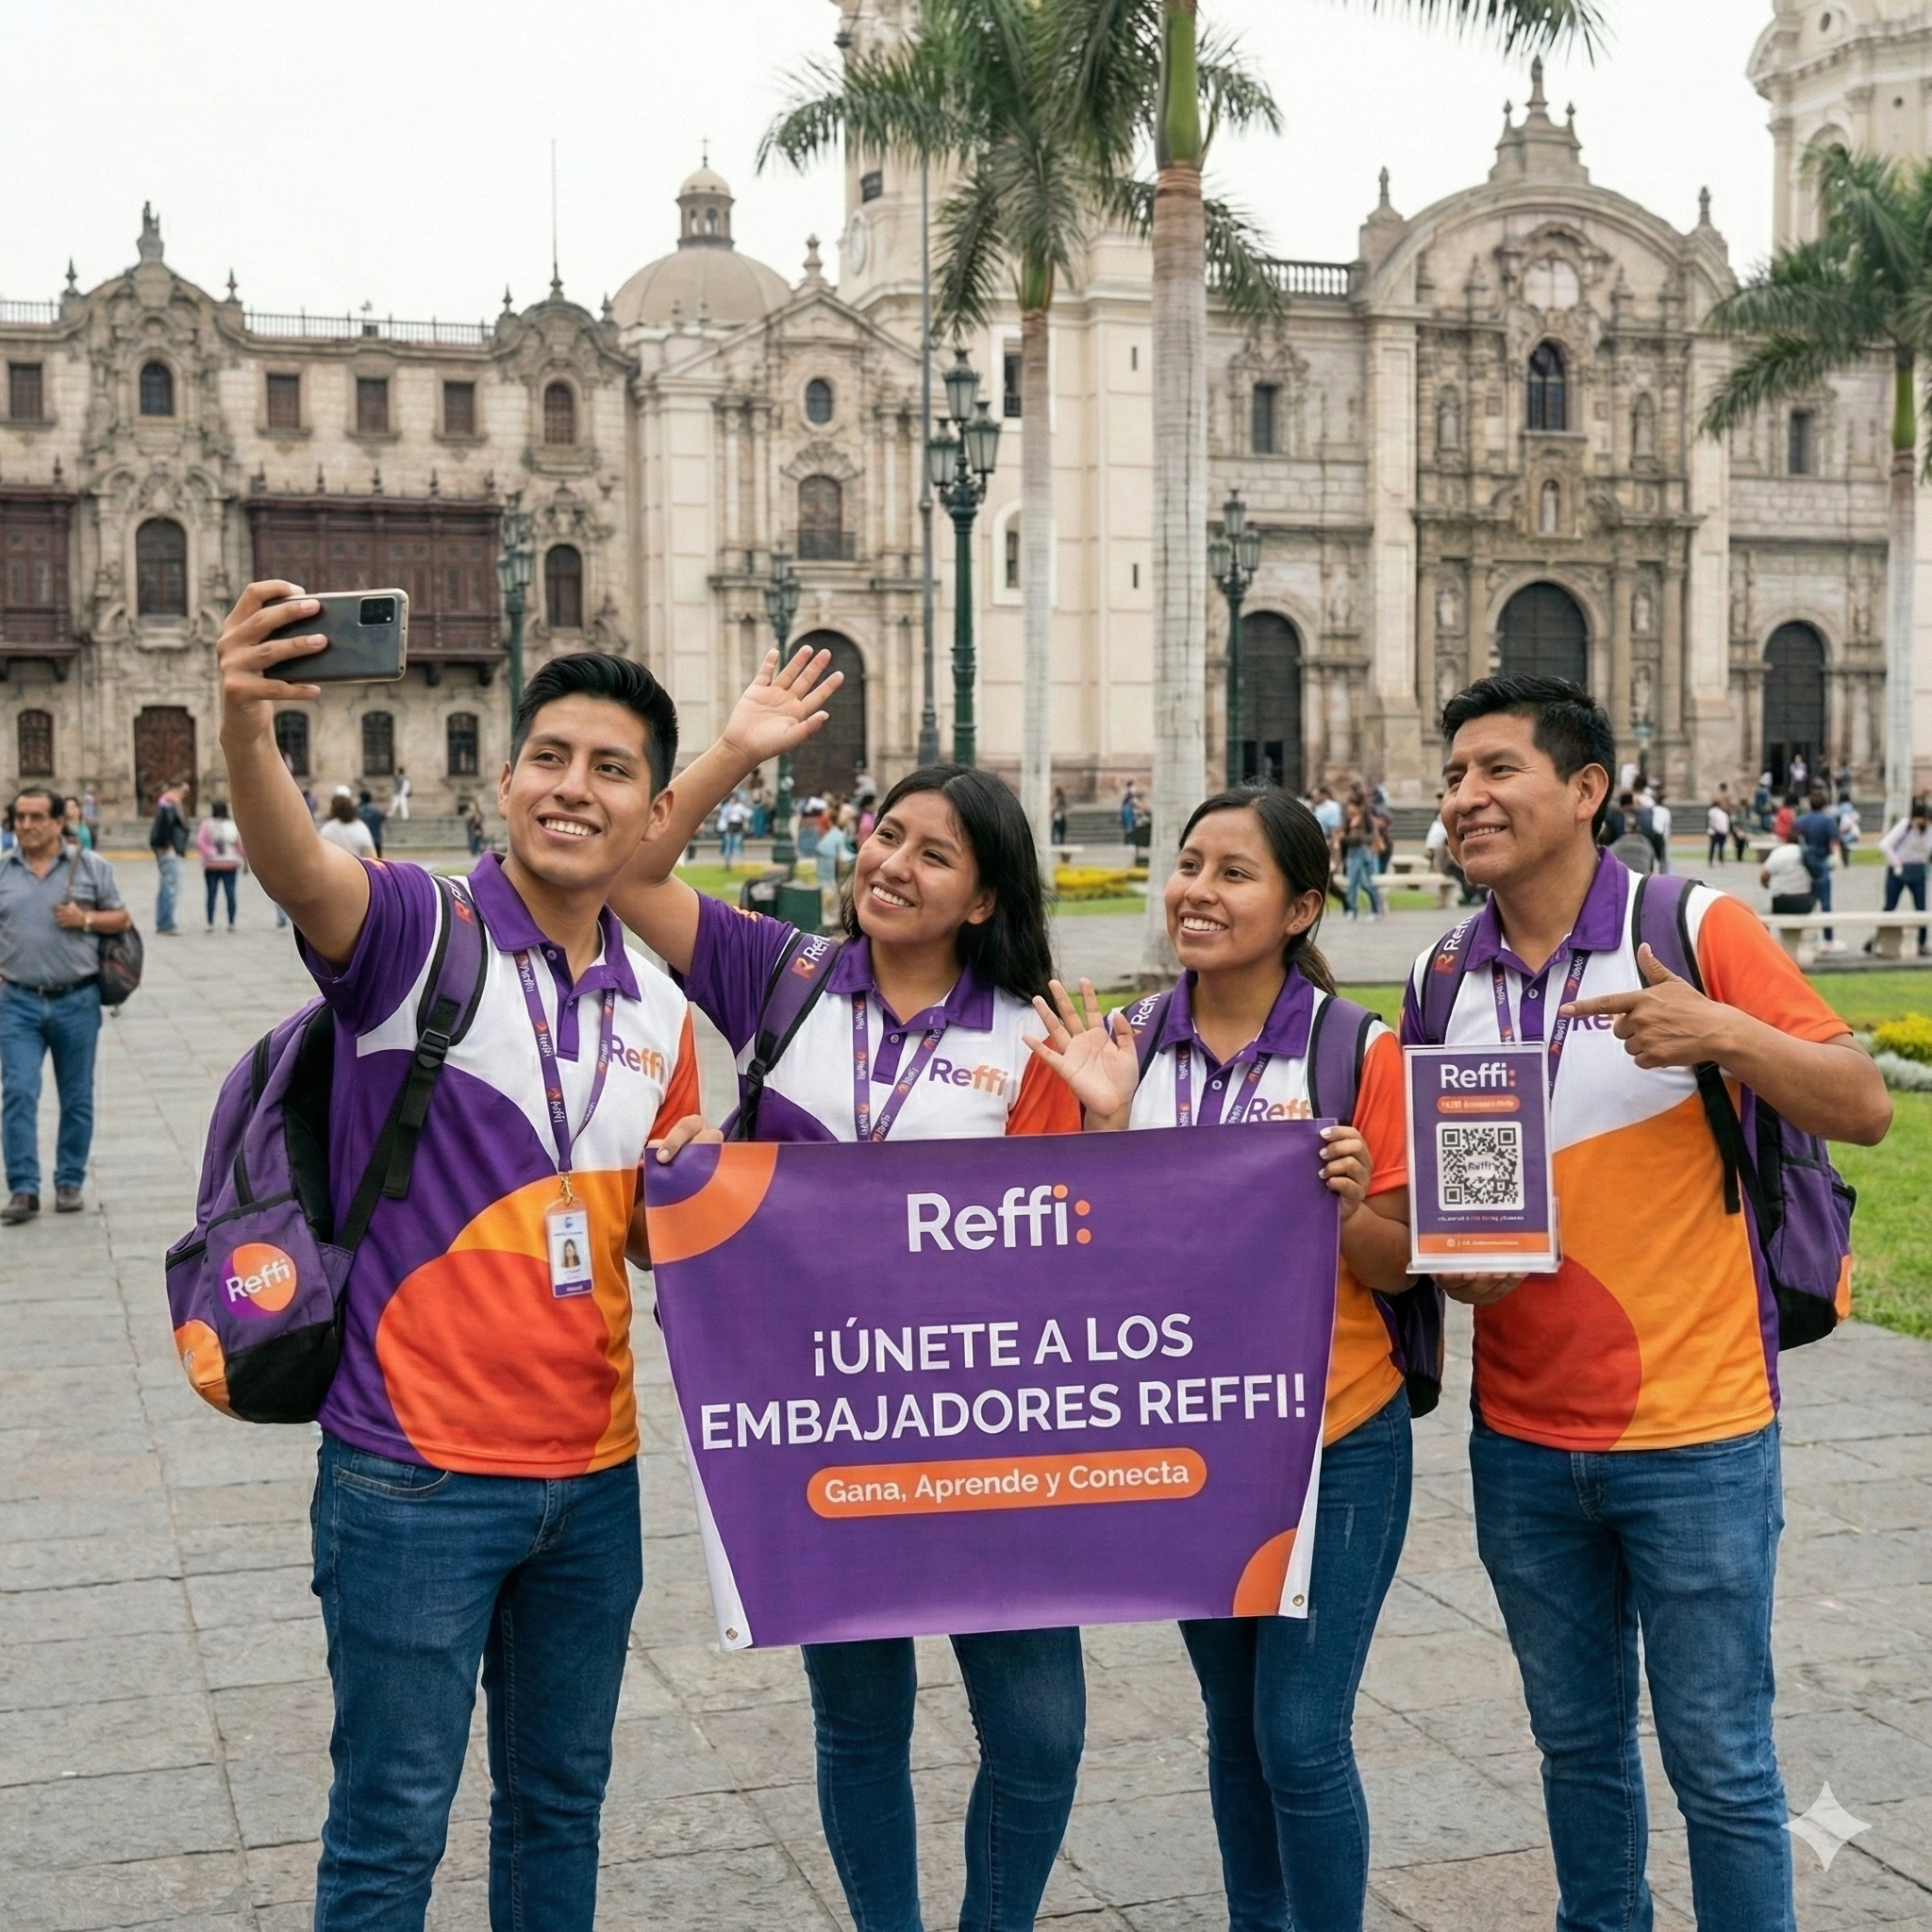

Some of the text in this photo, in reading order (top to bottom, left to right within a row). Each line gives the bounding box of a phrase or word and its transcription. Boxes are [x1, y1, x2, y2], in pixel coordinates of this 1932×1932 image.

[928, 1058, 1008, 1096] Reffi
[1245, 1098, 1310, 1123] Reff
[225, 1257, 291, 1303] Reffi
[814, 1313, 1194, 1376] ¡ÚNETE A LOS
[701, 1373, 1307, 1451] EMBAJADORES REFFI!
[824, 1460, 1190, 1505] Gana, Aprende y Conecta
